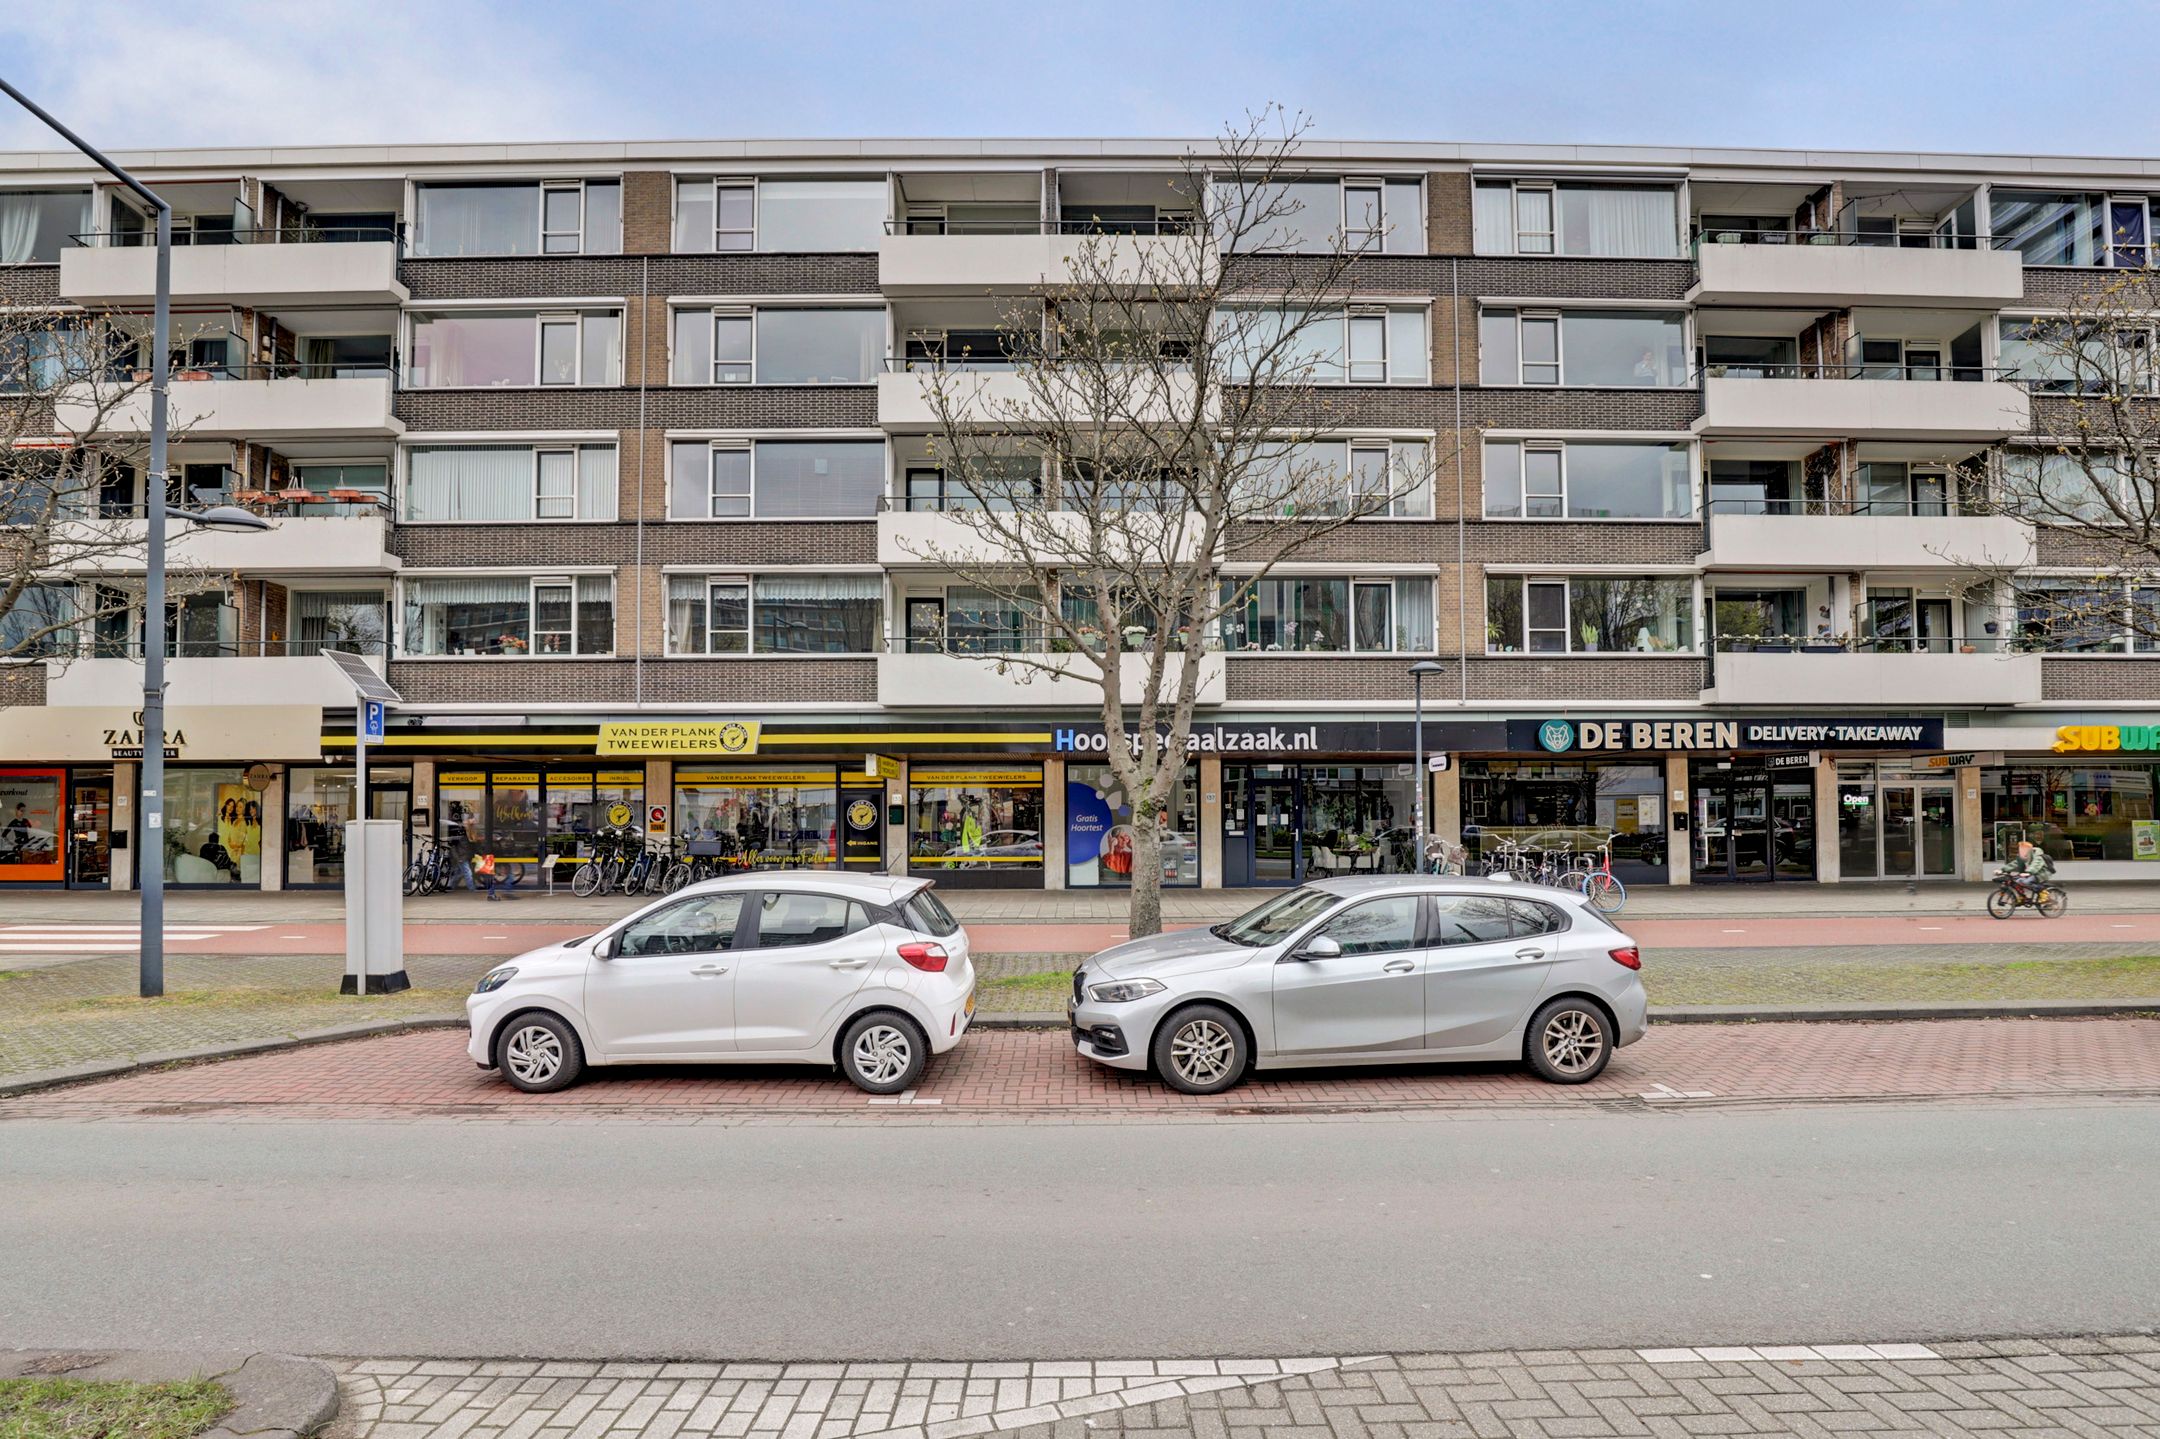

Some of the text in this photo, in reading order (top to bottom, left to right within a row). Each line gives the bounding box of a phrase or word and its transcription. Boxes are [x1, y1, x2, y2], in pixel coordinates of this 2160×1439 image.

[369, 704, 379, 721] P
[611, 727, 717, 737] VAN DER PLANK
[1580, 722, 1738, 749] DE BEREN
[1750, 726, 1923, 741] DELIVERY TAKEAWAY
[608, 739, 718, 749] TWEEWIELERS
[1056, 726, 1318, 755] Hoospeaalzaak.nl
[1775, 755, 1809, 766] DE BEREN
[1928, 754, 1975, 768] SUBWAY
[1843, 794, 1869, 809] Open
[1075, 814, 1098, 823] Gratis
[1071, 824, 1104, 832] Hoortest
